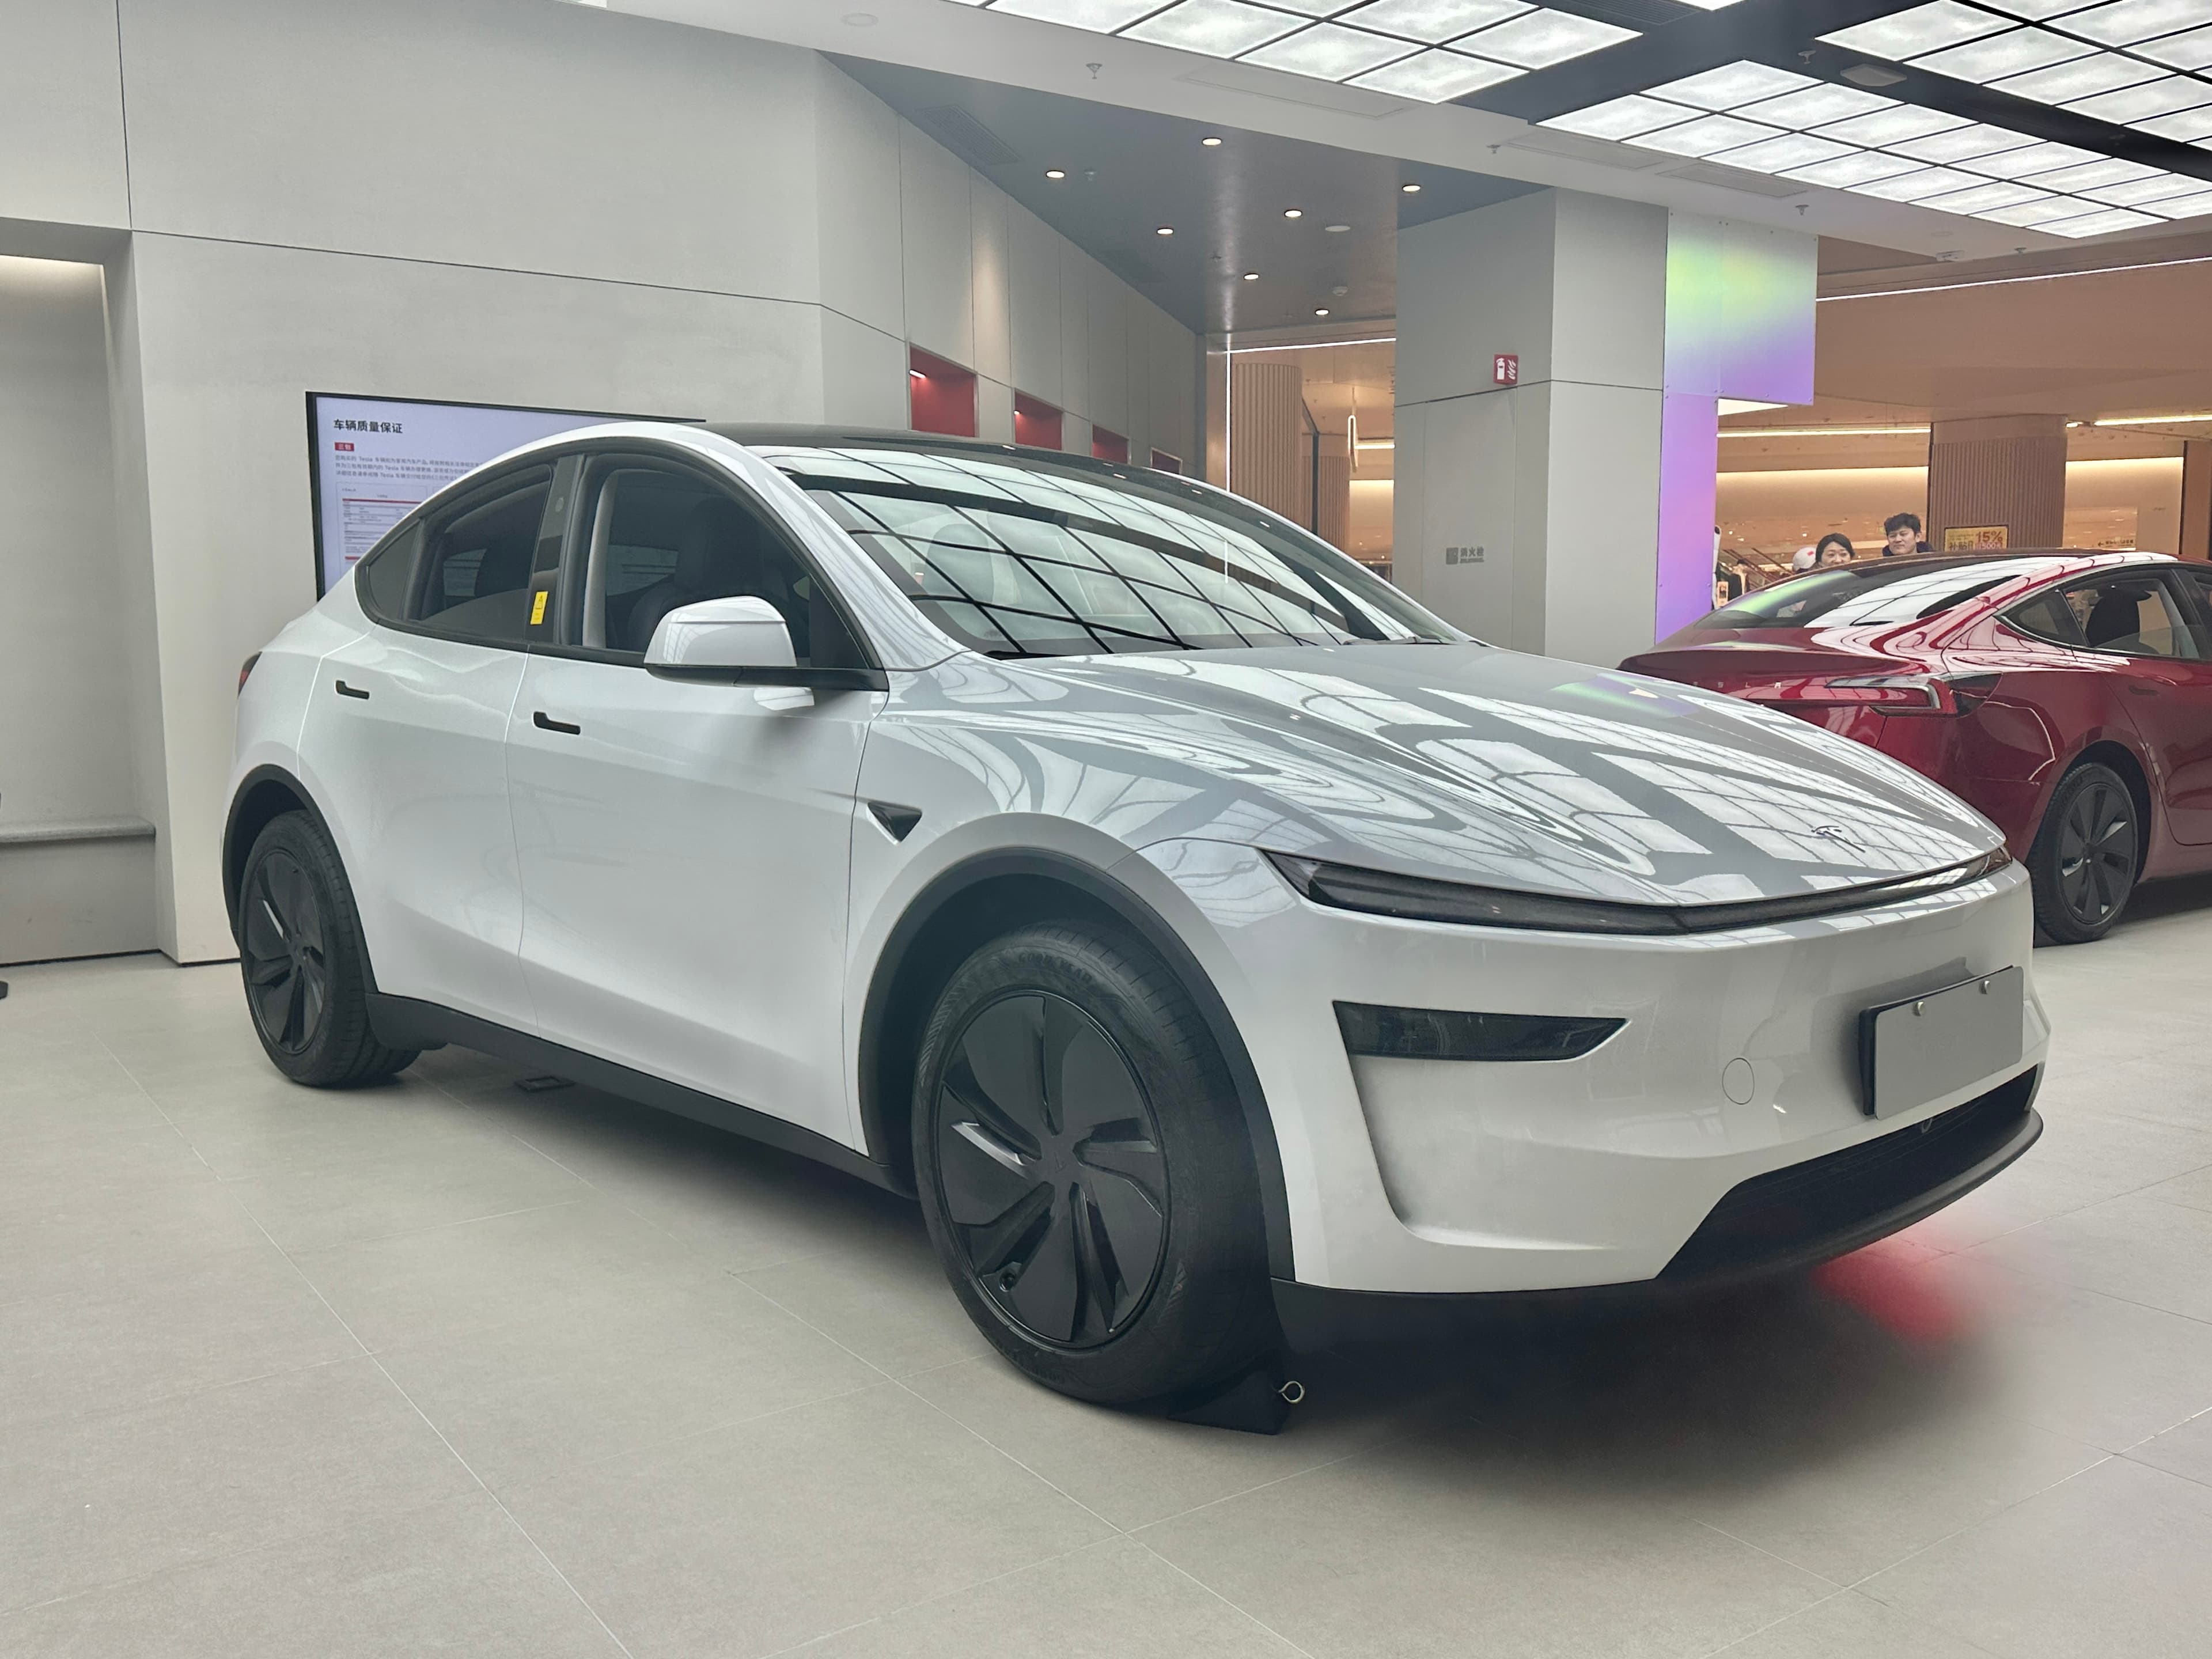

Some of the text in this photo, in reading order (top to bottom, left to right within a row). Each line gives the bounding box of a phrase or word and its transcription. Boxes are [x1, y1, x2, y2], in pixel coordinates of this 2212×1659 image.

[334, 419, 403, 433] 车辆质量保证
[1976, 531, 2003, 543] 15%
